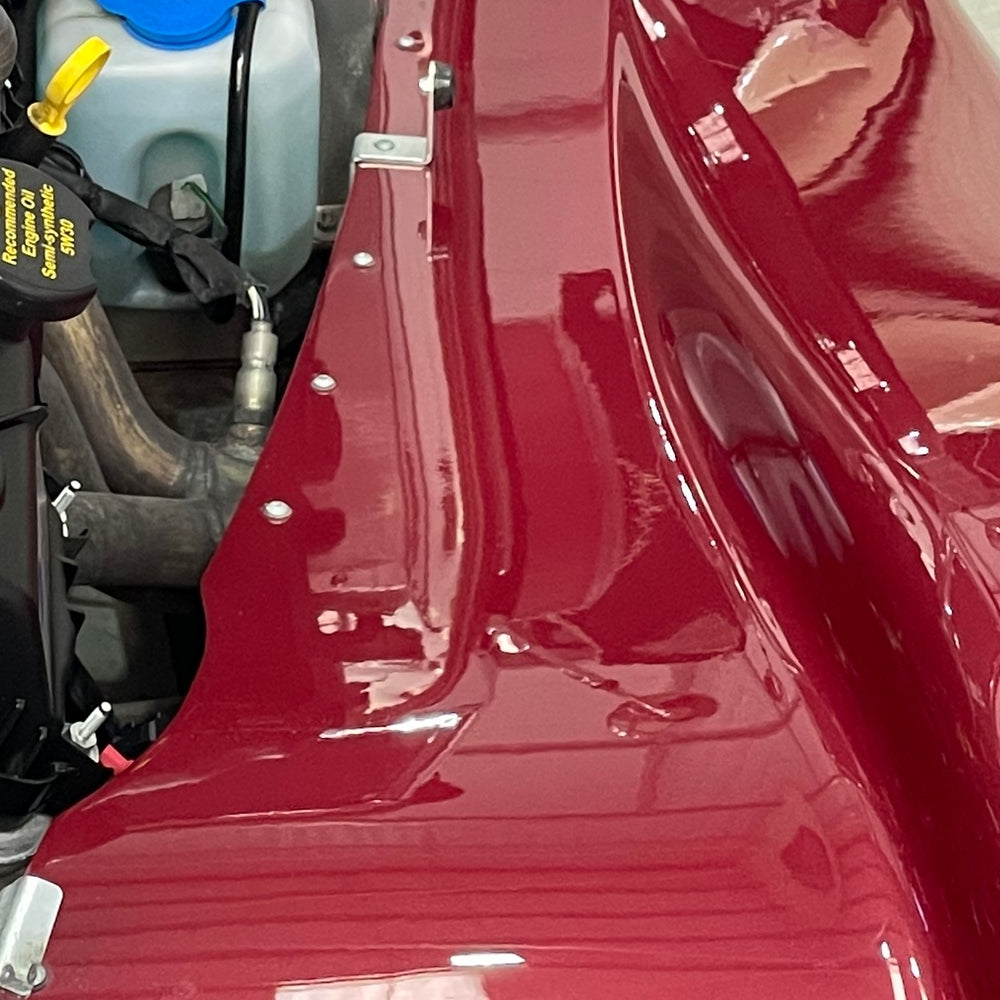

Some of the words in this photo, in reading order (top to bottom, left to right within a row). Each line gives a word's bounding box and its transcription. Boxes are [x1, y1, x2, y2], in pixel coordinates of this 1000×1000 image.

[1, 167, 17, 265] Recommended
[21, 189, 36, 209] Oil
[21, 210, 40, 258] Engine
[40, 183, 59, 280] Semi-synthetic
[59, 218, 76, 257] 5W30
